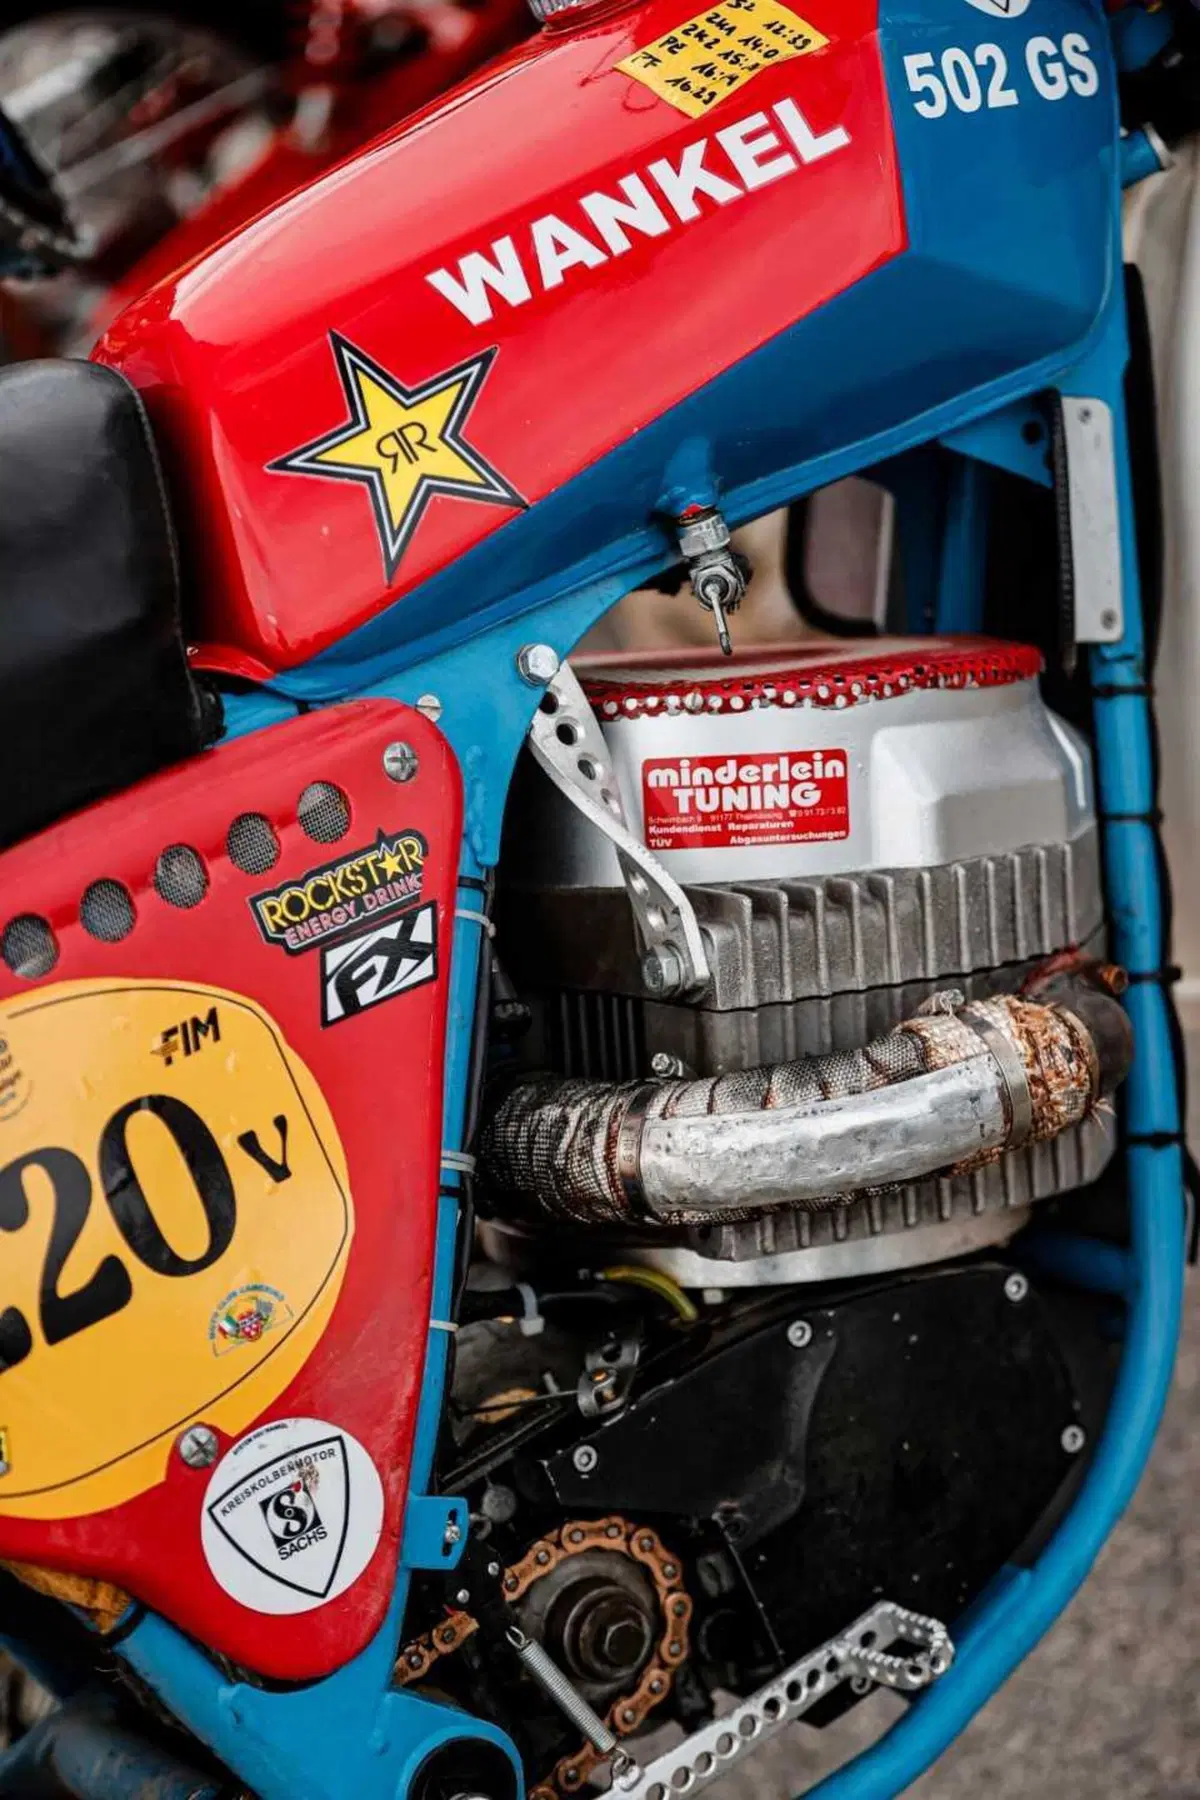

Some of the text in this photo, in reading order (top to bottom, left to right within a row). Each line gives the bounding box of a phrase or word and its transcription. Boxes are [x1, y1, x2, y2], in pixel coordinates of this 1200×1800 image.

[903, 33, 1099, 119] 502 GS
[425, 97, 851, 326] WANKEL
[648, 752, 845, 788] minderlein
[672, 782, 822, 814] TUNING
[649, 820, 794, 835] Kundendienst Reparaturen
[729, 829, 846, 846] Abgasuntersuchungen
[284, 874, 423, 945] ENERGY DRINK
[157, 1006, 221, 1067] FIM
[0, 1093, 237, 1377] 20
[220, 1447, 337, 1517] KREISKOLBENMOTOR
[277, 1525, 328, 1561] SACHS
